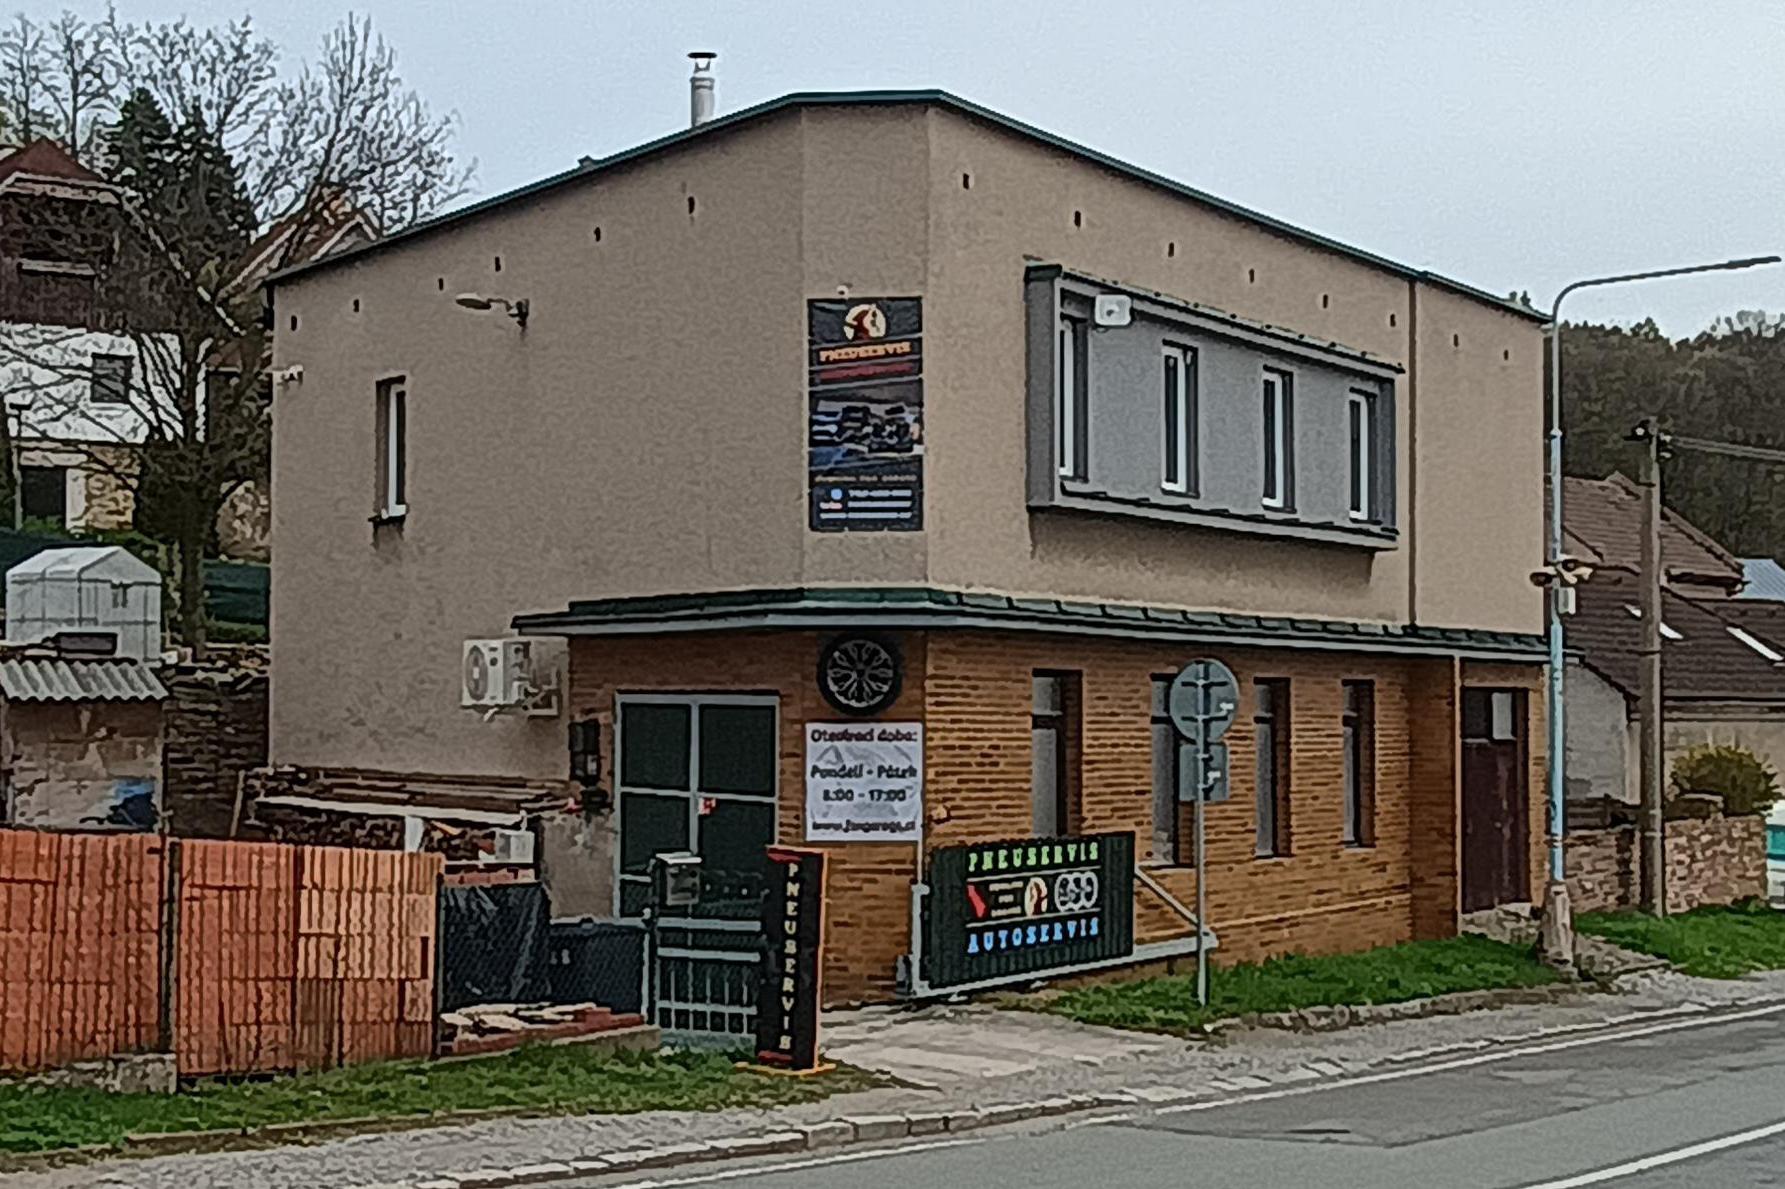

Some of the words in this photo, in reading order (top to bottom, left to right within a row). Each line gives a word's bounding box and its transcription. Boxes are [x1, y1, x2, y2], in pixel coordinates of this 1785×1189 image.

[968, 842, 1099, 872] PNEUSERVIS
[967, 917, 1099, 954] AUTOSERVIS
[779, 863, 799, 1050] PNEUSERVIS
